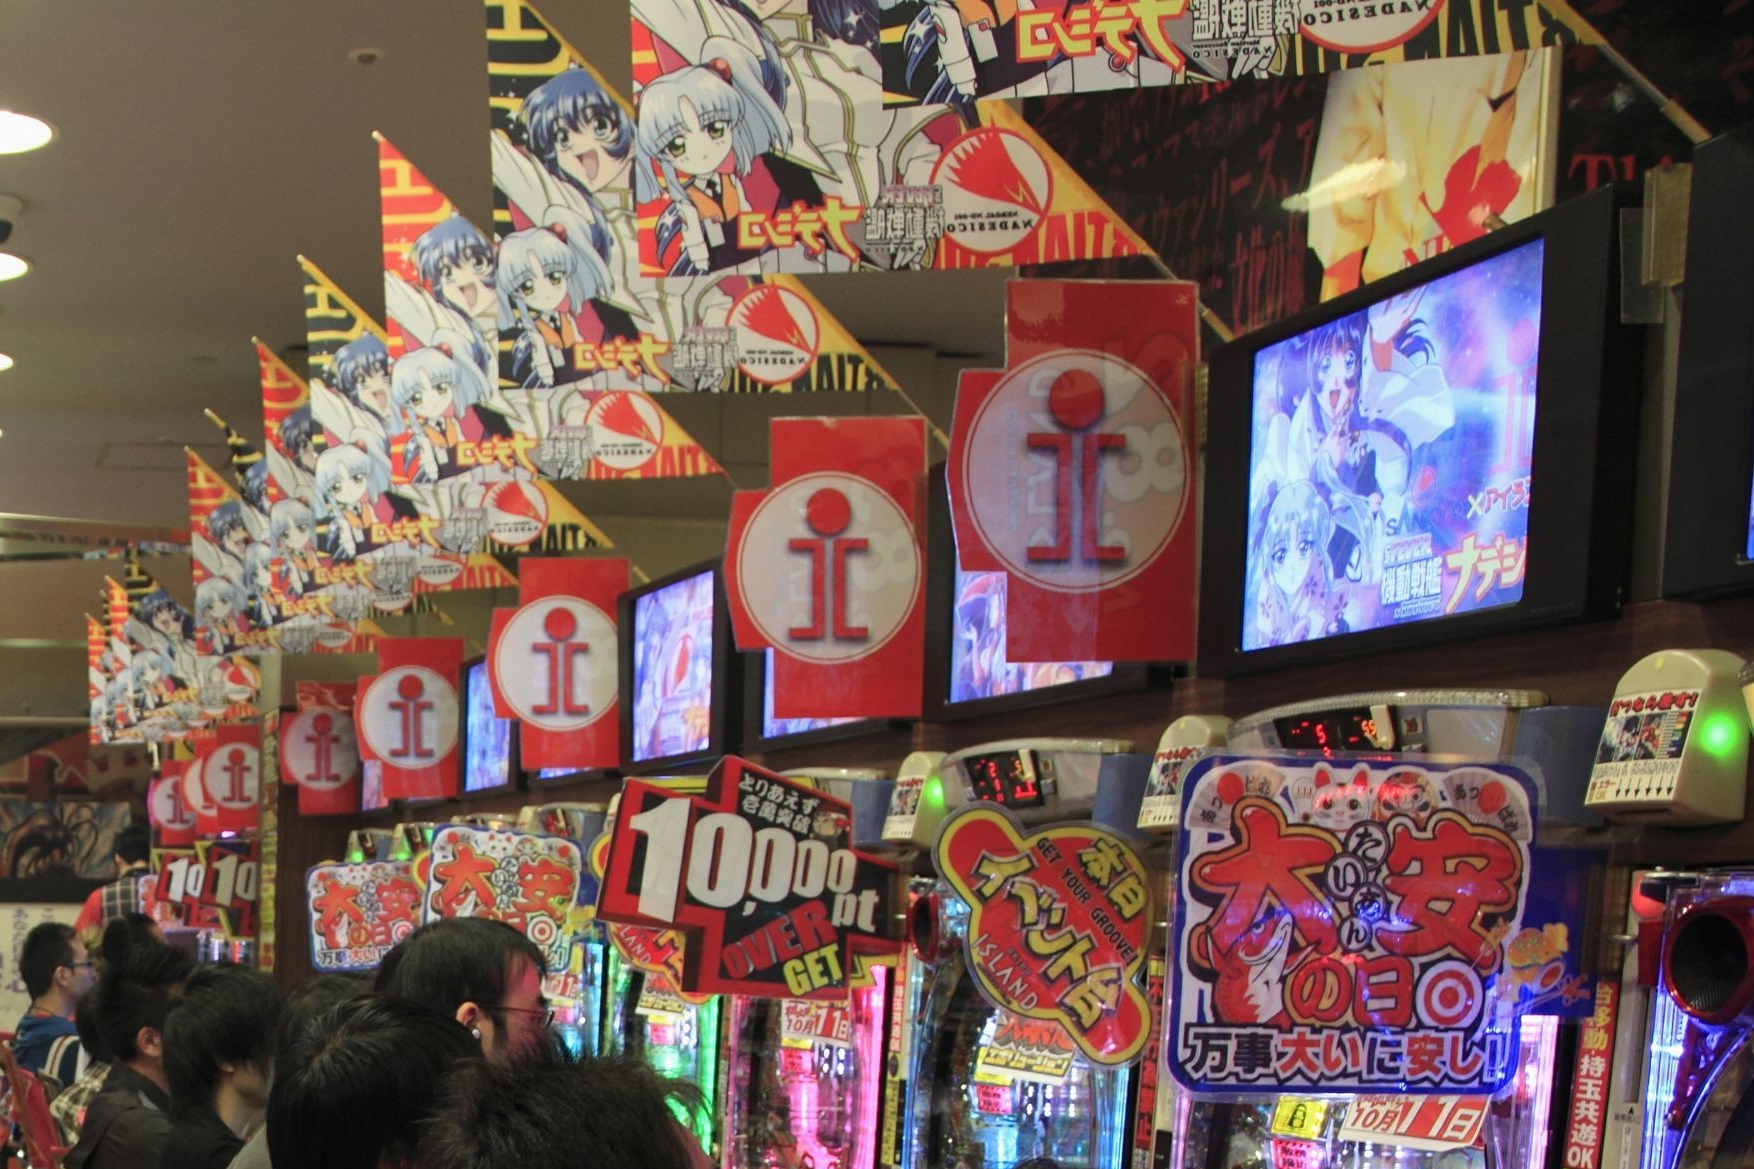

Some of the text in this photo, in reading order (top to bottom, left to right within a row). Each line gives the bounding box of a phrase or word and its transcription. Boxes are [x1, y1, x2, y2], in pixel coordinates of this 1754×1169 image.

[628, 797, 881, 934] 10,000 pt
[1034, 836, 1140, 967] GET YOUR GROOVE!
[1078, 836, 1147, 921] 本日
[721, 899, 839, 980] OVER
[781, 942, 845, 997] GET
[972, 932, 1039, 1012] ISLAND
[1286, 955, 1415, 1028] の日
